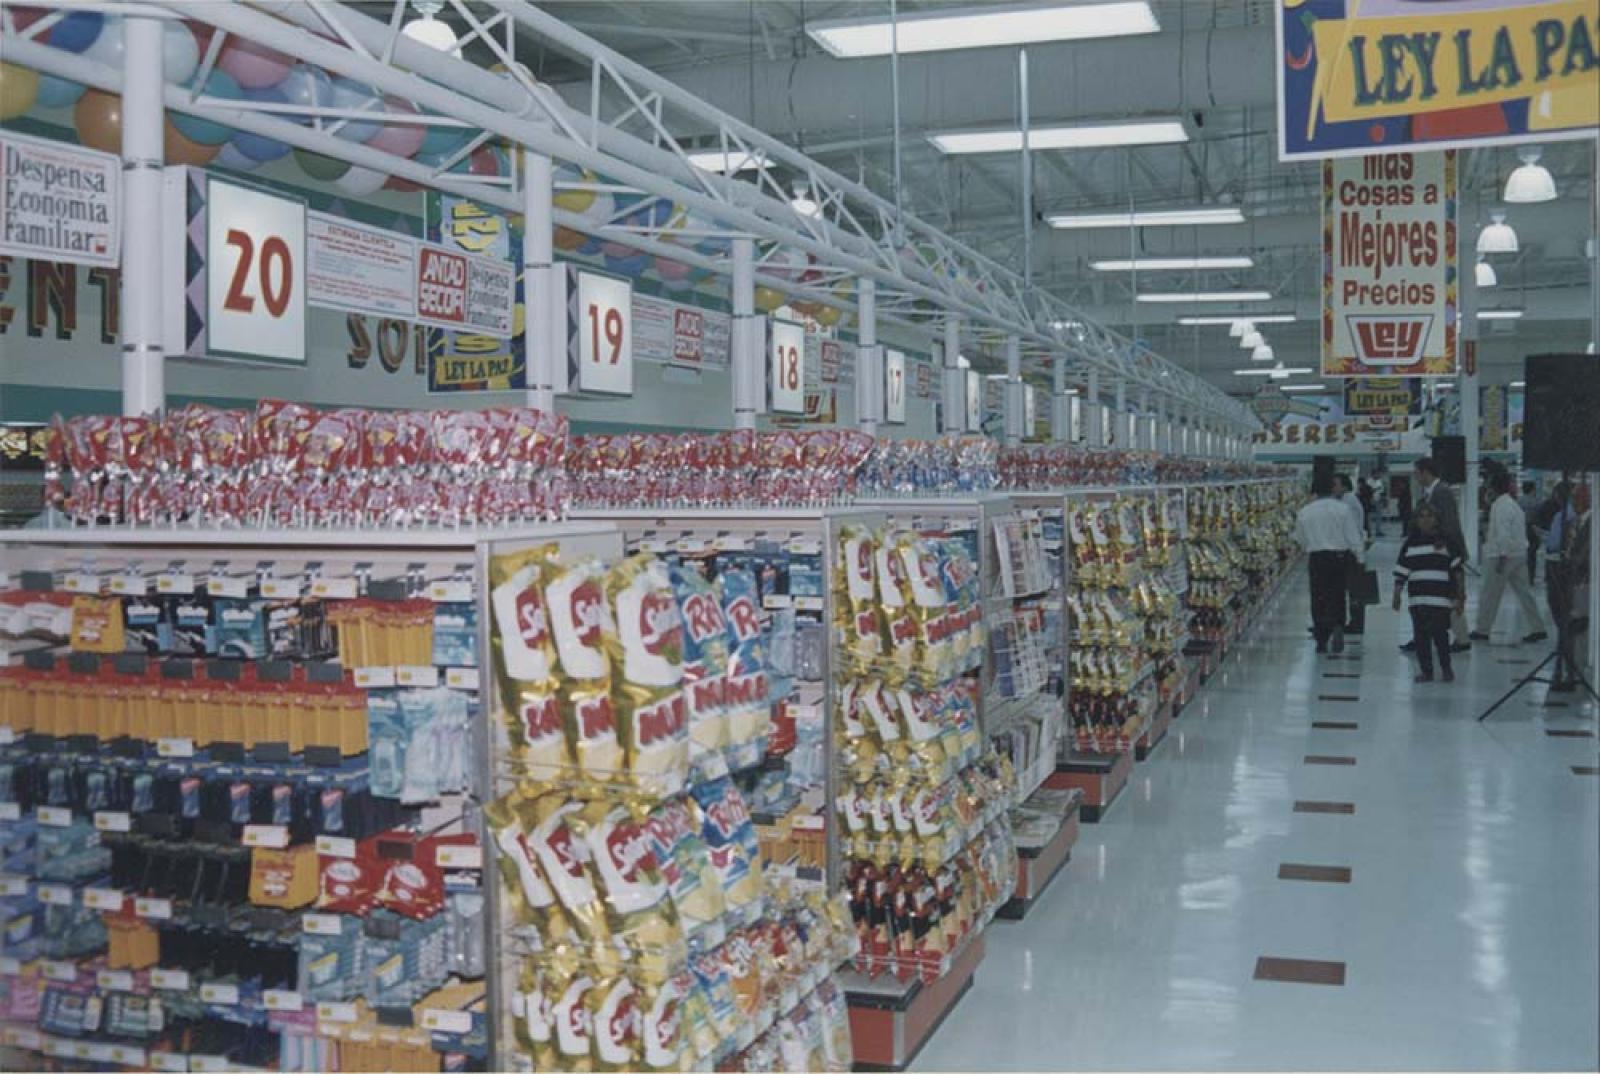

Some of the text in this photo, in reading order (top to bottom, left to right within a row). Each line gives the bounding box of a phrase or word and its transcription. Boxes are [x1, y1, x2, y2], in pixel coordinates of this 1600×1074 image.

[1348, 14, 1600, 106] LEY LA PA
[5, 146, 106, 193] Despensa
[1339, 180, 1438, 206] Cosas a
[5, 179, 108, 223] Economía
[1340, 210, 1438, 279] Mejores
[223, 229, 293, 318] 20
[1343, 279, 1435, 305] Precios
[588, 304, 623, 364] 19
[779, 346, 798, 390] 18
